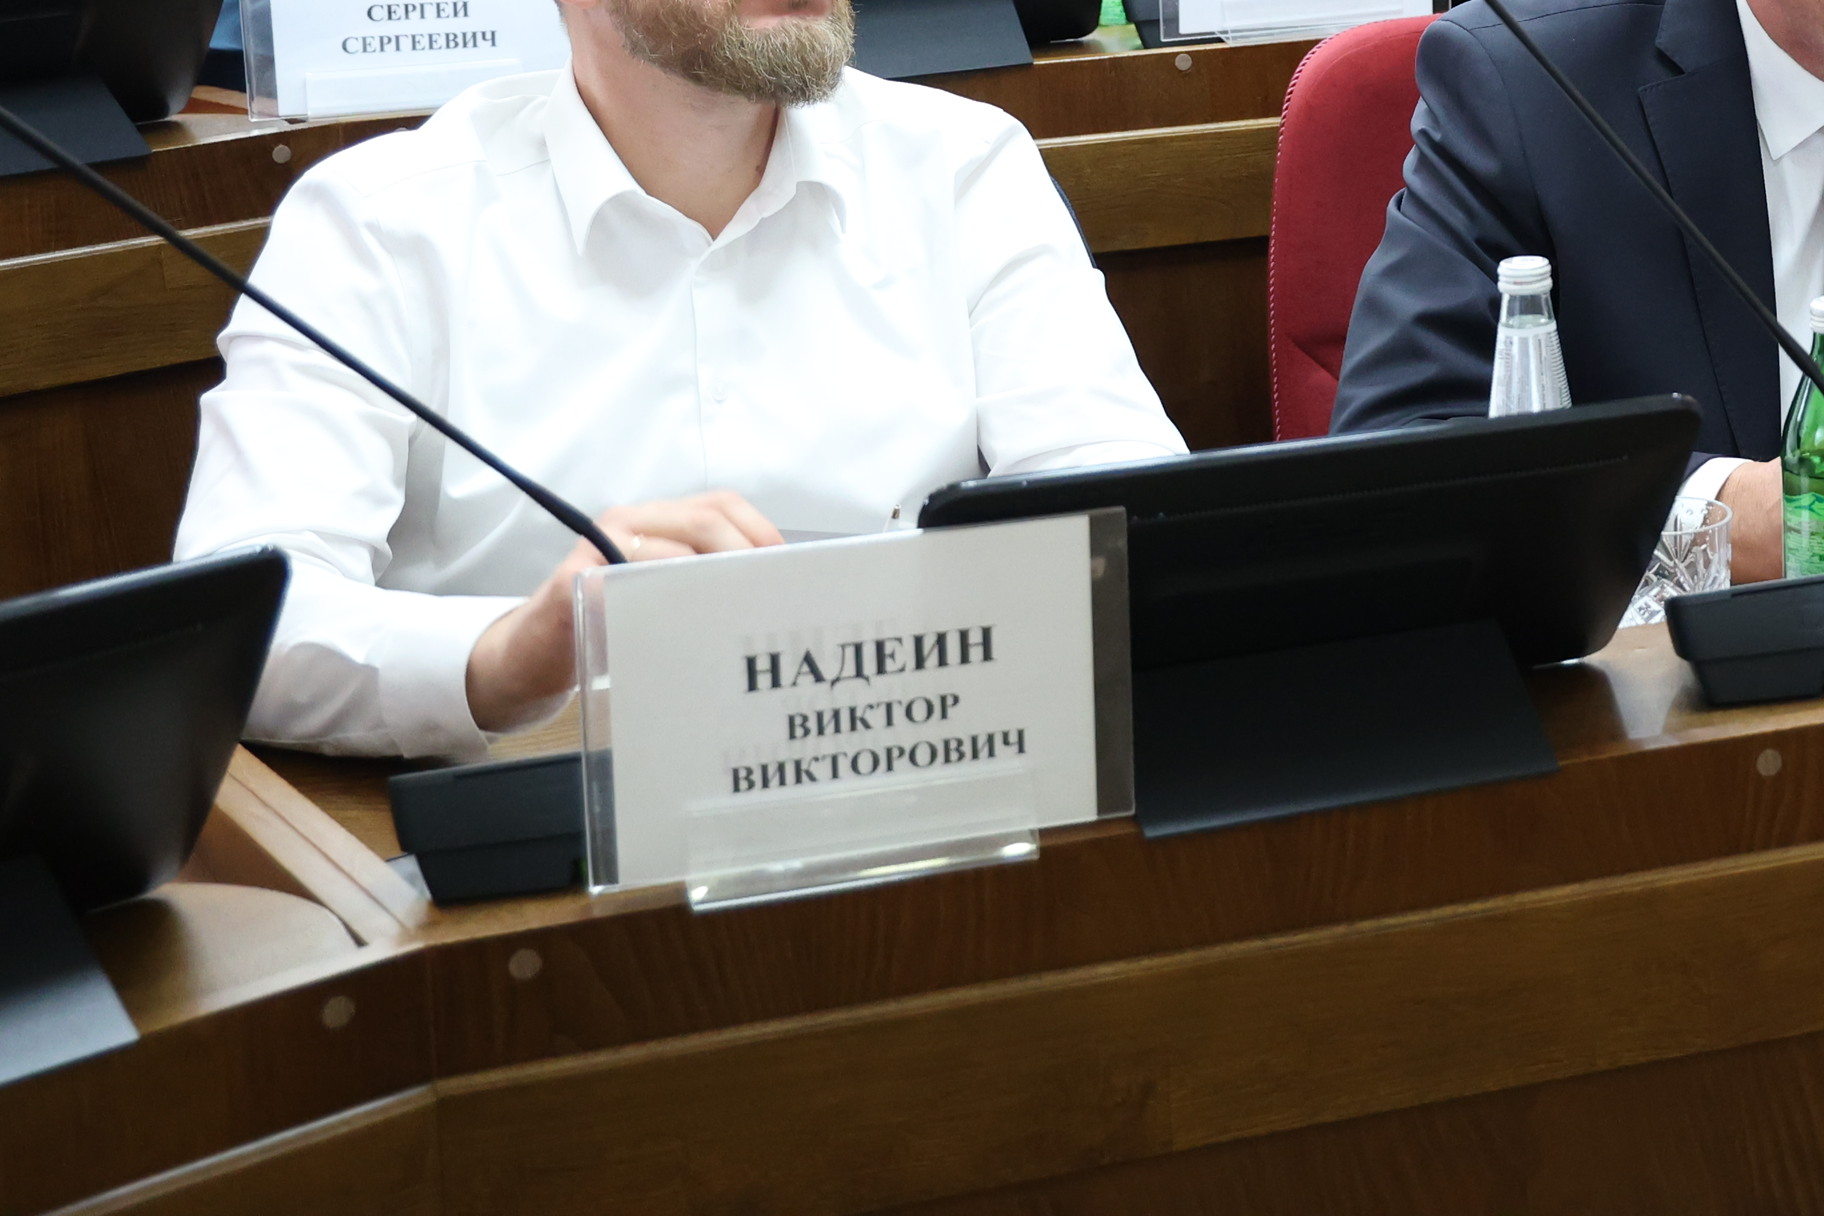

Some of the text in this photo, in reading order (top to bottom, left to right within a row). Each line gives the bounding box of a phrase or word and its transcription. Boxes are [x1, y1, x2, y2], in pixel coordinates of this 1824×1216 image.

[340, 29, 498, 55] СЕРГЕЕВИЧ
[742, 624, 997, 694] НАДЕИН
[785, 691, 962, 742] ВИКТОР
[730, 727, 1028, 795] ВИКТОРОВИЧ
